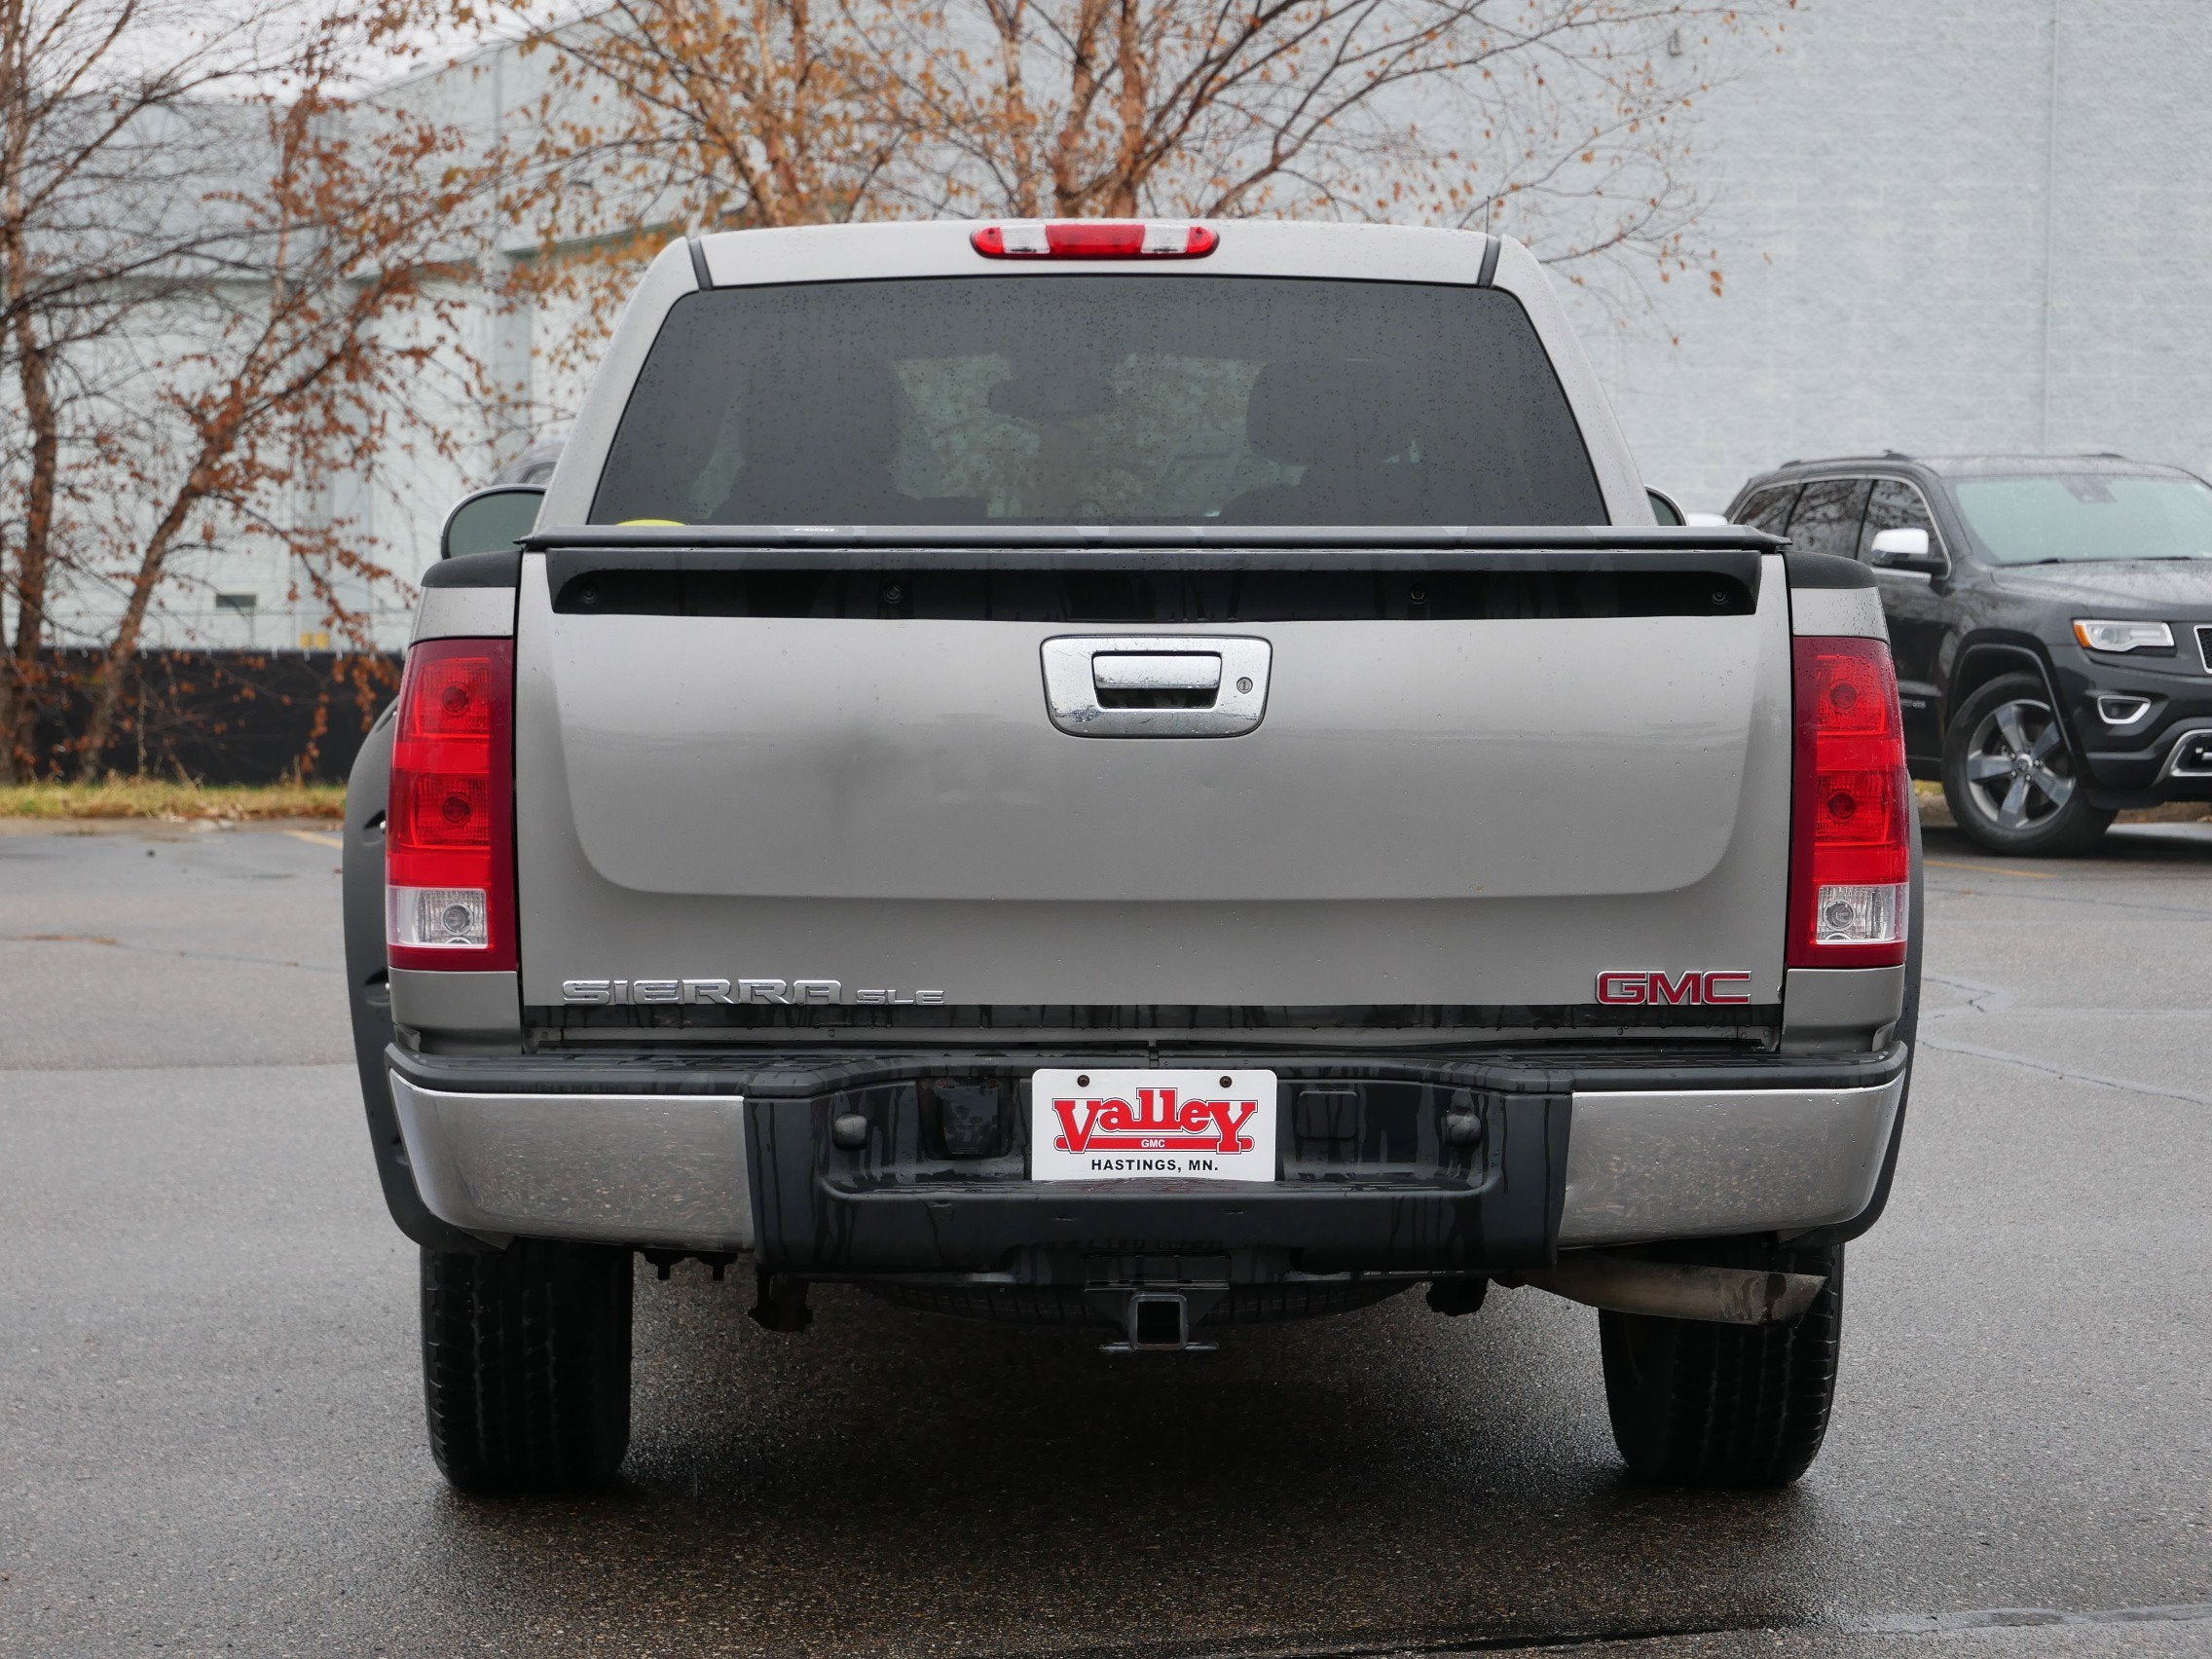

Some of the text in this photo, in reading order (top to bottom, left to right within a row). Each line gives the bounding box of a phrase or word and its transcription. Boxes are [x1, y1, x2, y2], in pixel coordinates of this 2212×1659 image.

[562, 978, 945, 1005] SIERRA SLE
[1597, 971, 1751, 1005] GMC
[1140, 1139, 1165, 1148] GMC
[1091, 1159, 1219, 1173] HASTINGS, MN.
